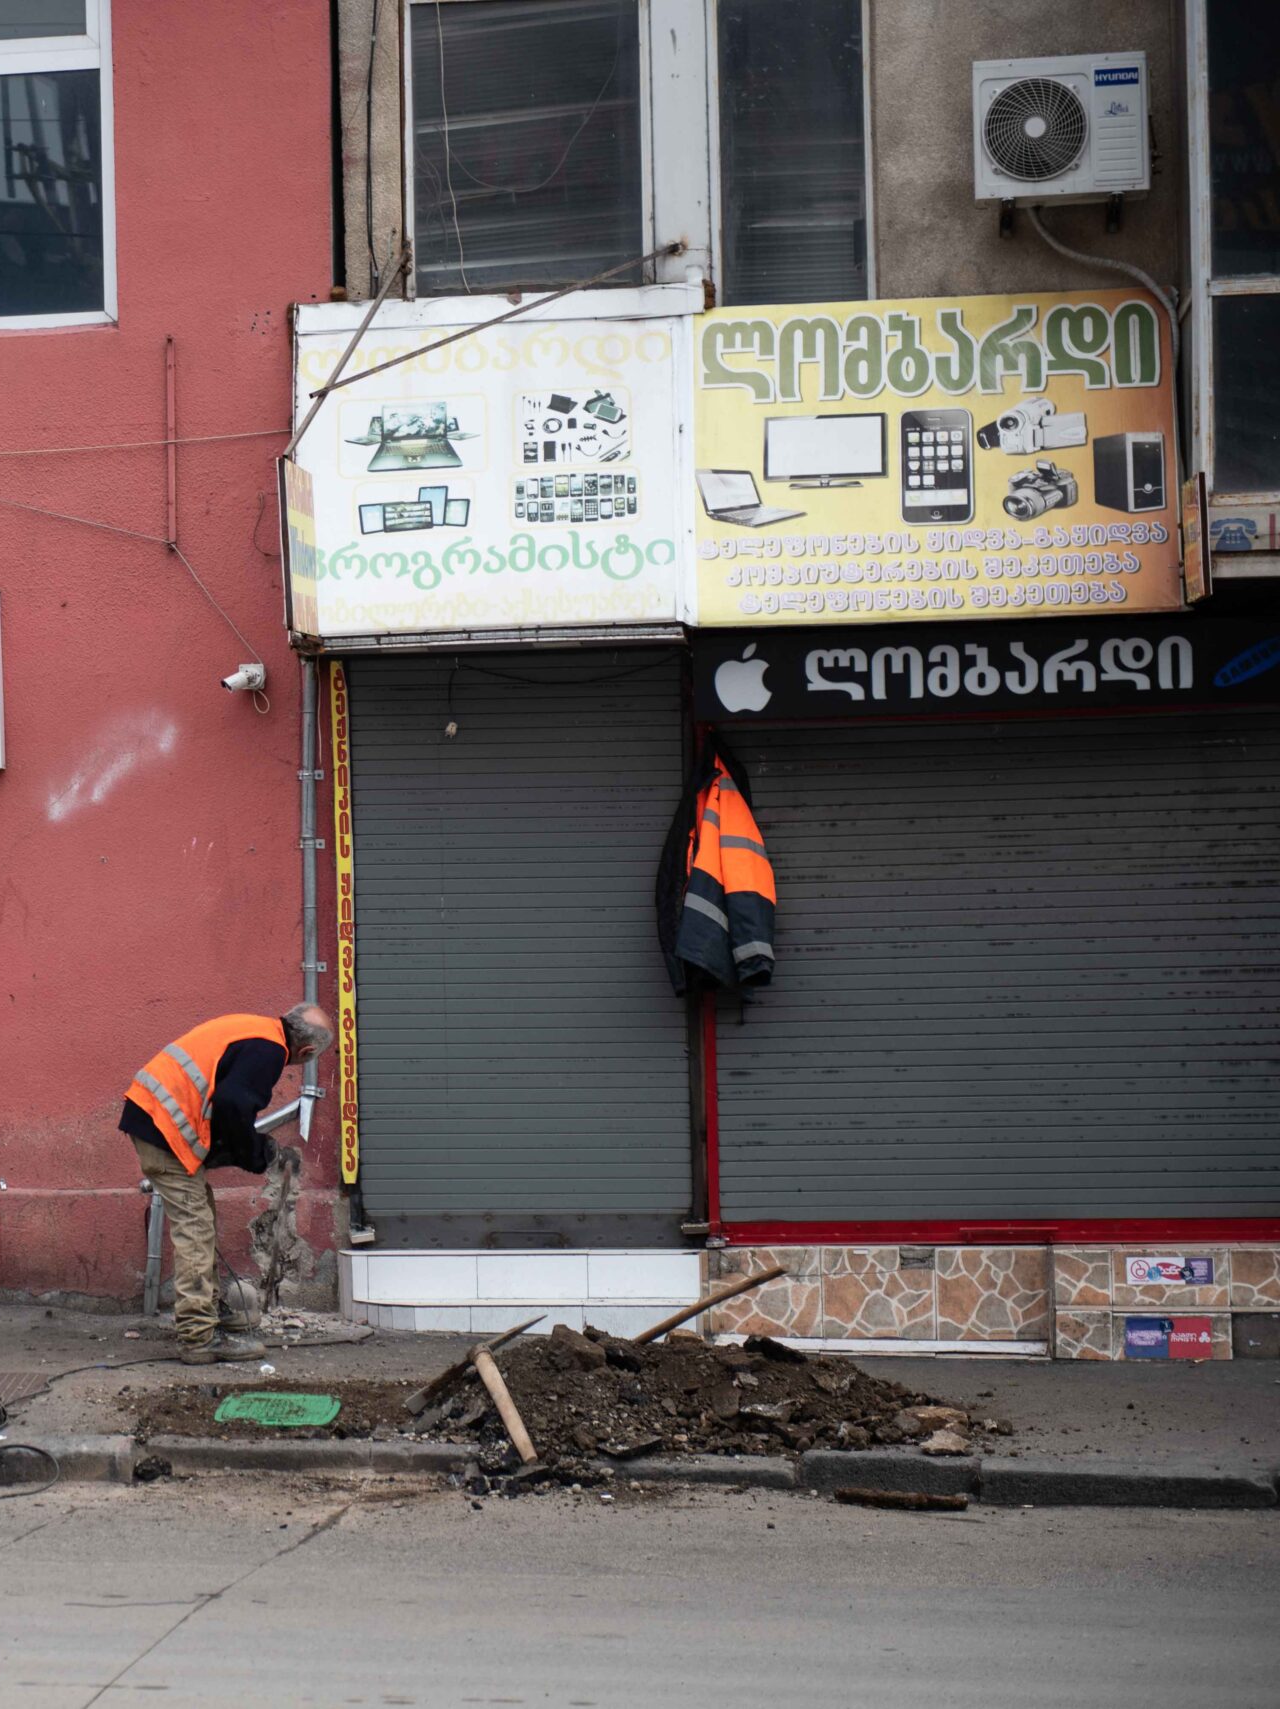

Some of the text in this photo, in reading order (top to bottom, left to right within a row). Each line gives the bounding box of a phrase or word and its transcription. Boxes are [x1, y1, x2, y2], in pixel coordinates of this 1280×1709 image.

[1095, 72, 1138, 82] HYUNDAI
[701, 301, 1161, 403] ლომბარდი
[698, 532, 919, 560] ტელეფონების
[726, 550, 1140, 588] კომპიუტერების შეკეთება
[739, 580, 1127, 615] ტელეფონების შეკეთება
[804, 635, 1194, 701] ლომბარდი
[340, 872, 355, 993] ყიდვა
[342, 1008, 357, 1172] გაყიდვა
